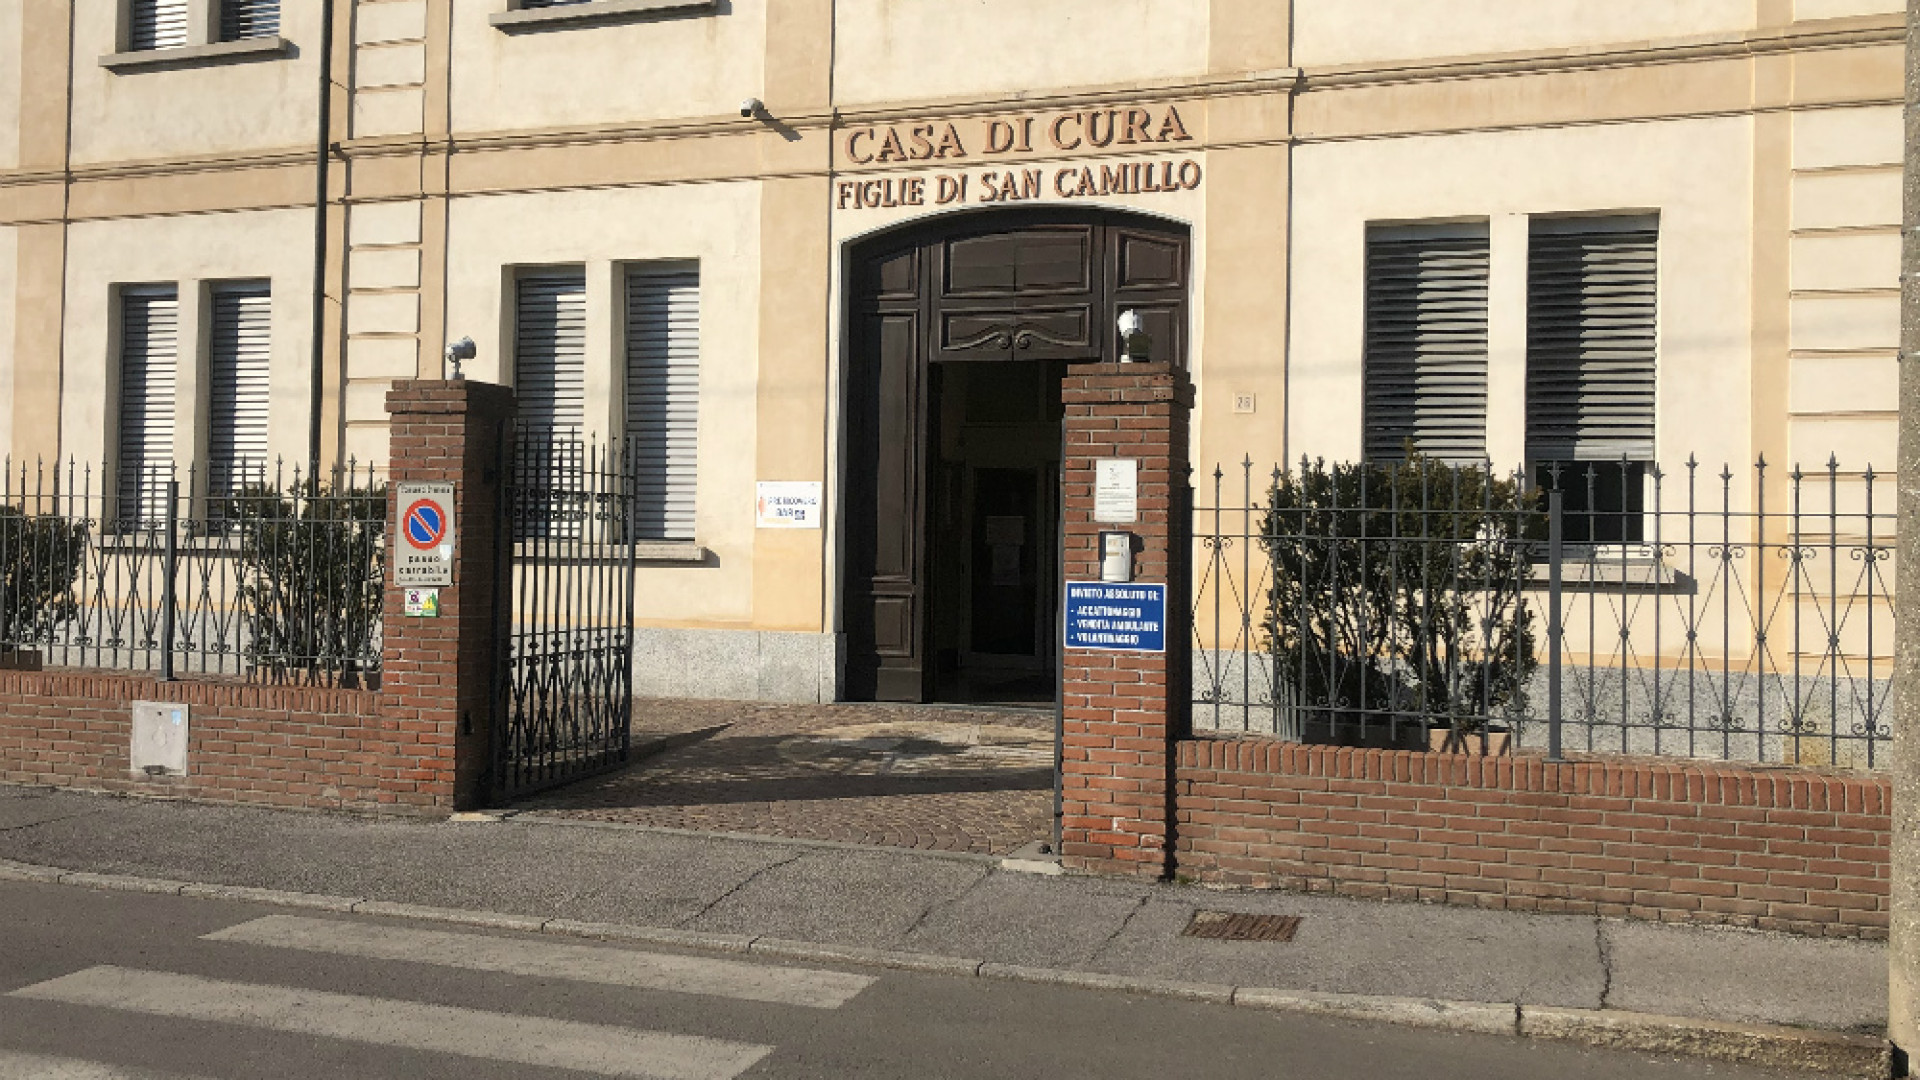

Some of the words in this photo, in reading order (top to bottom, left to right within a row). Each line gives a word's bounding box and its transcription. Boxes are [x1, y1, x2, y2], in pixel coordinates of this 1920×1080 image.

[844, 122, 967, 164] CASA
[983, 116, 1035, 154] DI
[1049, 104, 1194, 151] CURA
[836, 178, 926, 210] FIGLIE
[935, 172, 968, 205] DI
[979, 168, 1042, 202] SAN
[1053, 158, 1202, 198] CAMILLO
[1070, 587, 1103, 599] DIVIETO
[1104, 588, 1147, 600] ASSOLUTO
[1076, 605, 1142, 618] ACCATTONAGGIO
[1076, 619, 1110, 630] VENDITA
[1111, 620, 1159, 632] AMBULANTE
[1076, 632, 1139, 645] VOLANTINAGGIO
